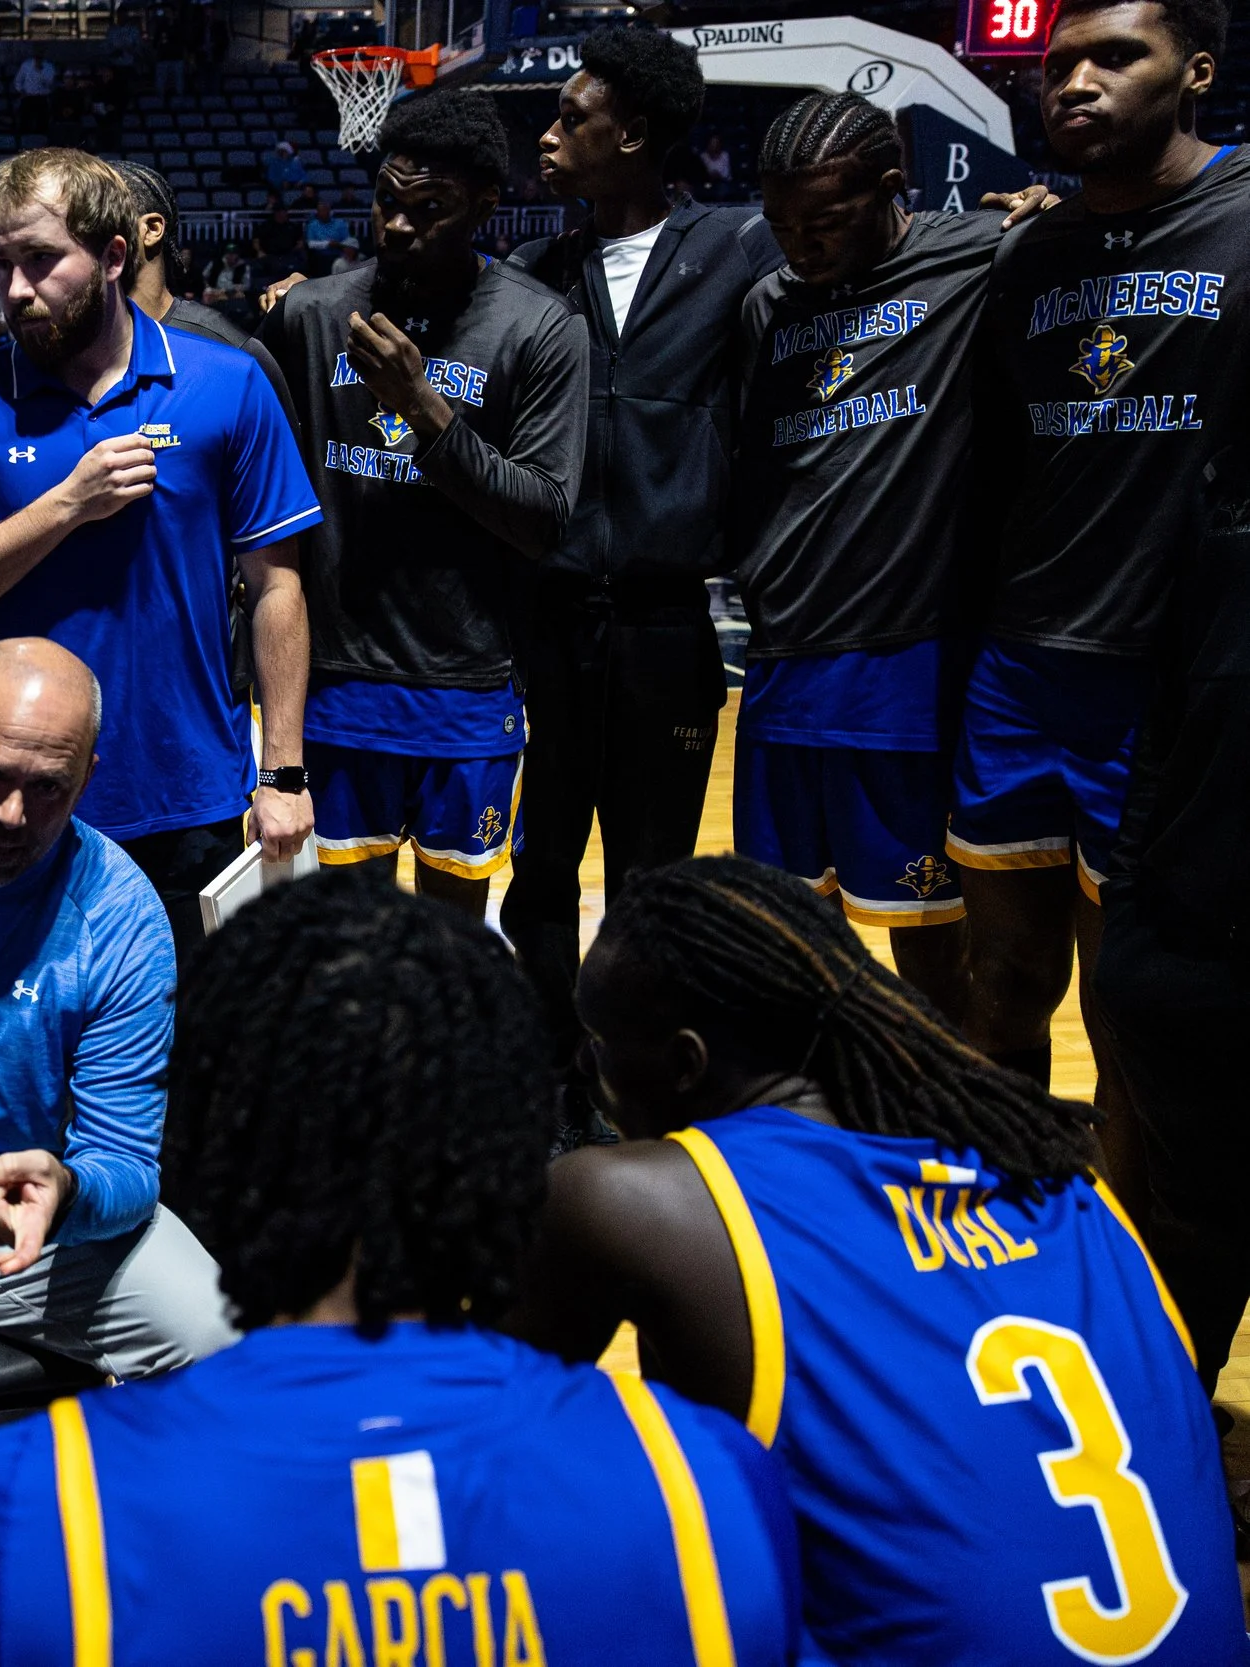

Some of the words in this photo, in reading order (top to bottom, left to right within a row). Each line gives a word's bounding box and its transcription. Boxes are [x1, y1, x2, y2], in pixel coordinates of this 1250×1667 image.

[693, 23, 783, 48] SPALDING
[990, 0, 1038, 38] 30
[548, 46, 582, 70] DU
[1027, 270, 1225, 340] McNEESE
[330, 352, 488, 407] MESE
[772, 384, 926, 447] BASKETBALL
[1028, 394, 1203, 437] BSKETBALL
[325, 440, 438, 487] BASKETB
[882, 1184, 1039, 1273] DUAL
[966, 1314, 1190, 1667] 3
[260, 1569, 547, 1667] GARCIA
